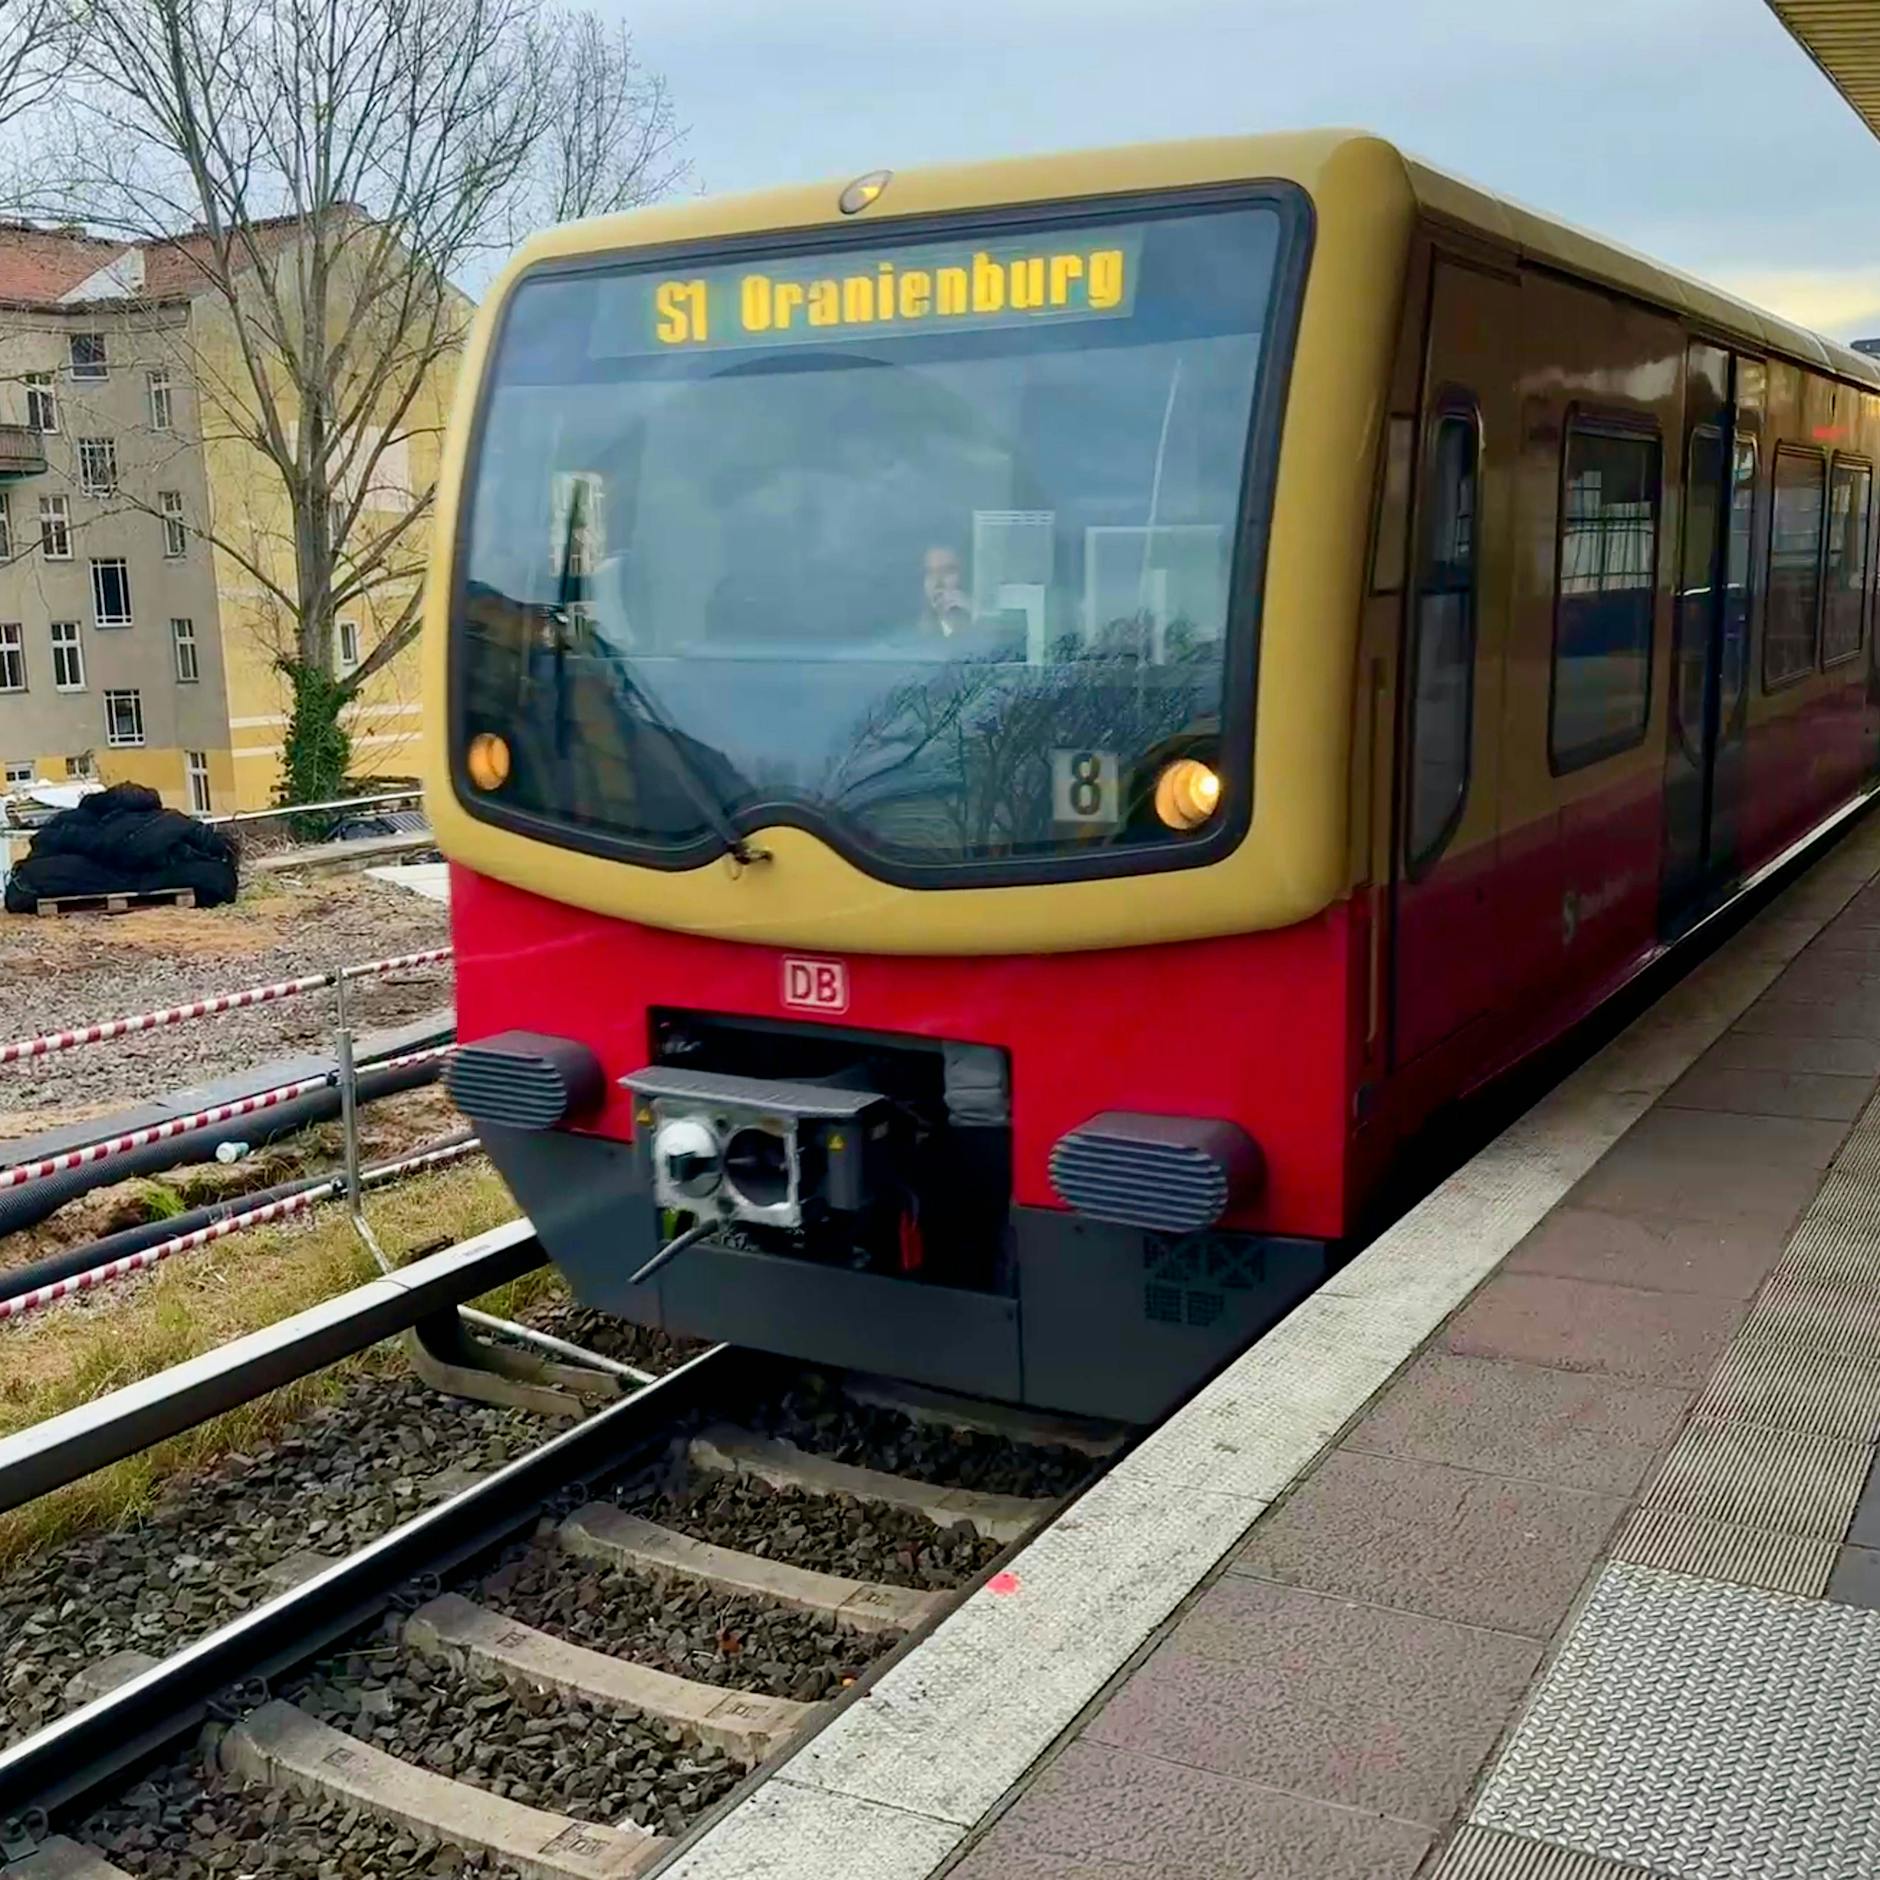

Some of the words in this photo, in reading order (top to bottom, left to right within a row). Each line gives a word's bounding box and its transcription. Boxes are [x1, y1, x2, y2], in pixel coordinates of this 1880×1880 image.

[656, 279, 708, 344] S1
[740, 249, 1124, 332] Oranienburg
[1069, 752, 1101, 816] 8
[790, 963, 838, 1003] DB
